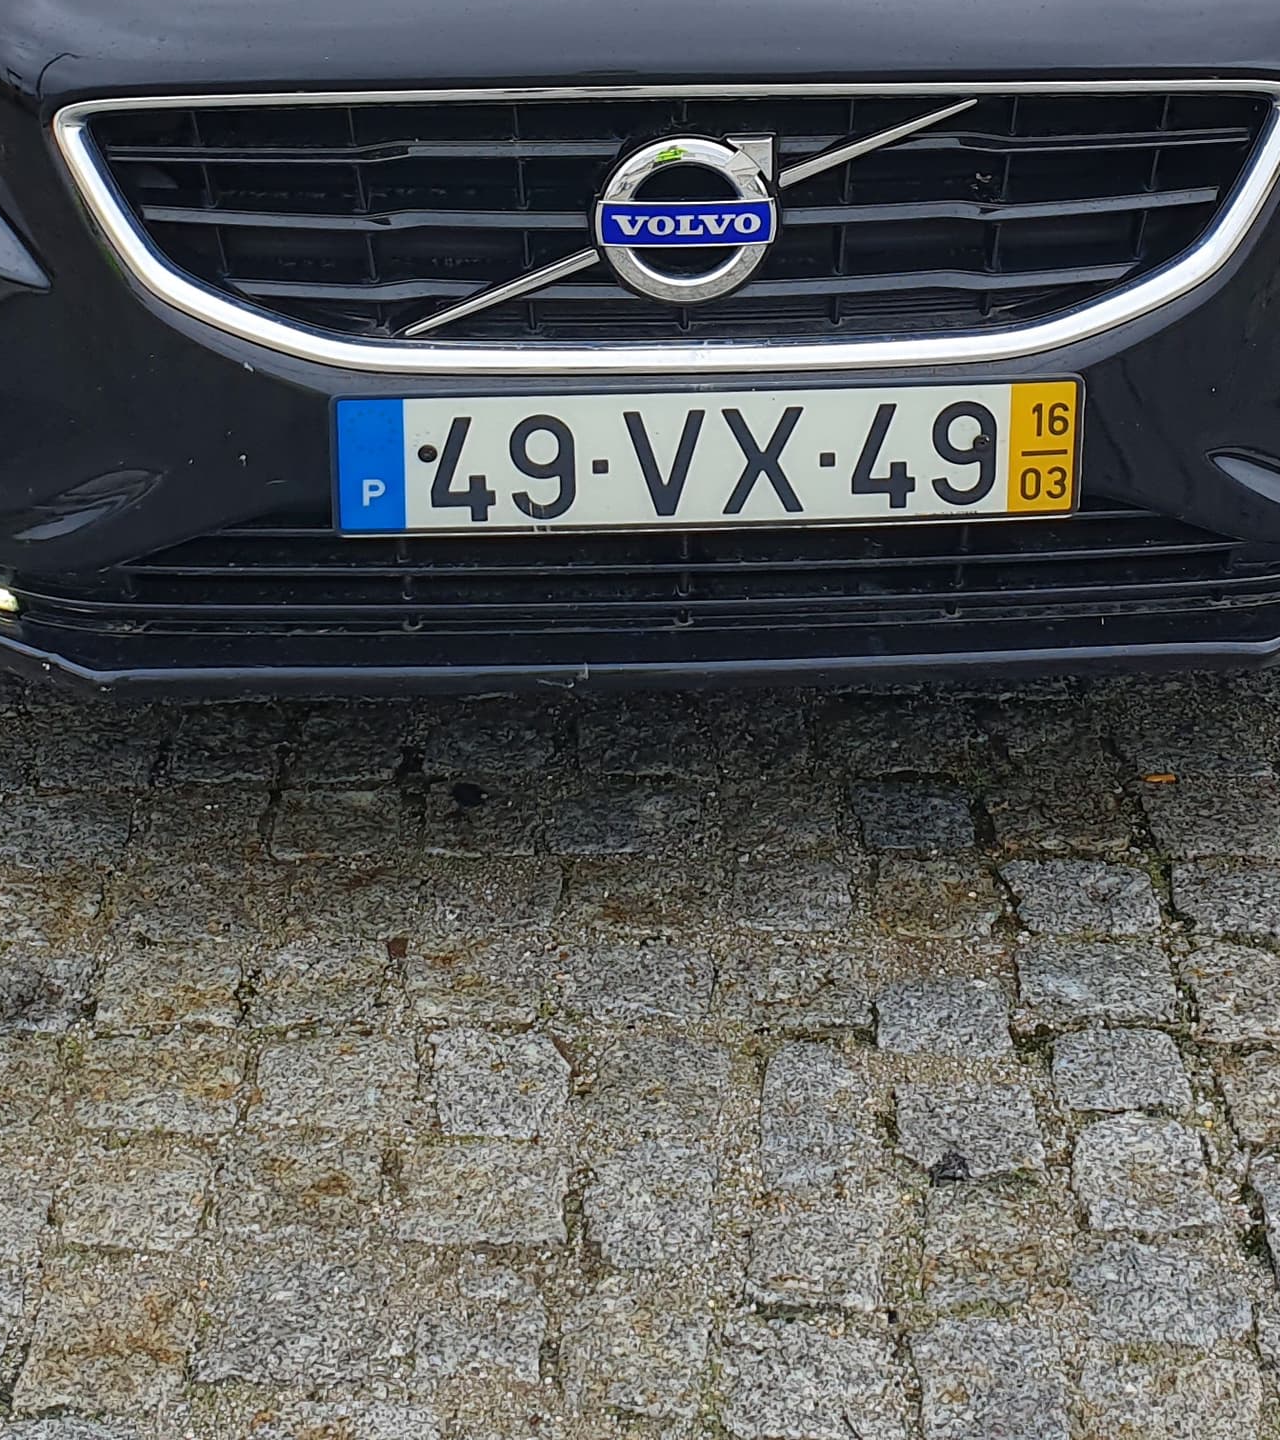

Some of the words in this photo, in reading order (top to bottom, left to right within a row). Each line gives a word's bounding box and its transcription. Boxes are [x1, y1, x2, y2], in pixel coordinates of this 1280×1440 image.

[611, 213, 762, 236] VOLVO
[1032, 402, 1069, 437] 16
[362, 479, 386, 506] P
[1020, 465, 1067, 501] 03
